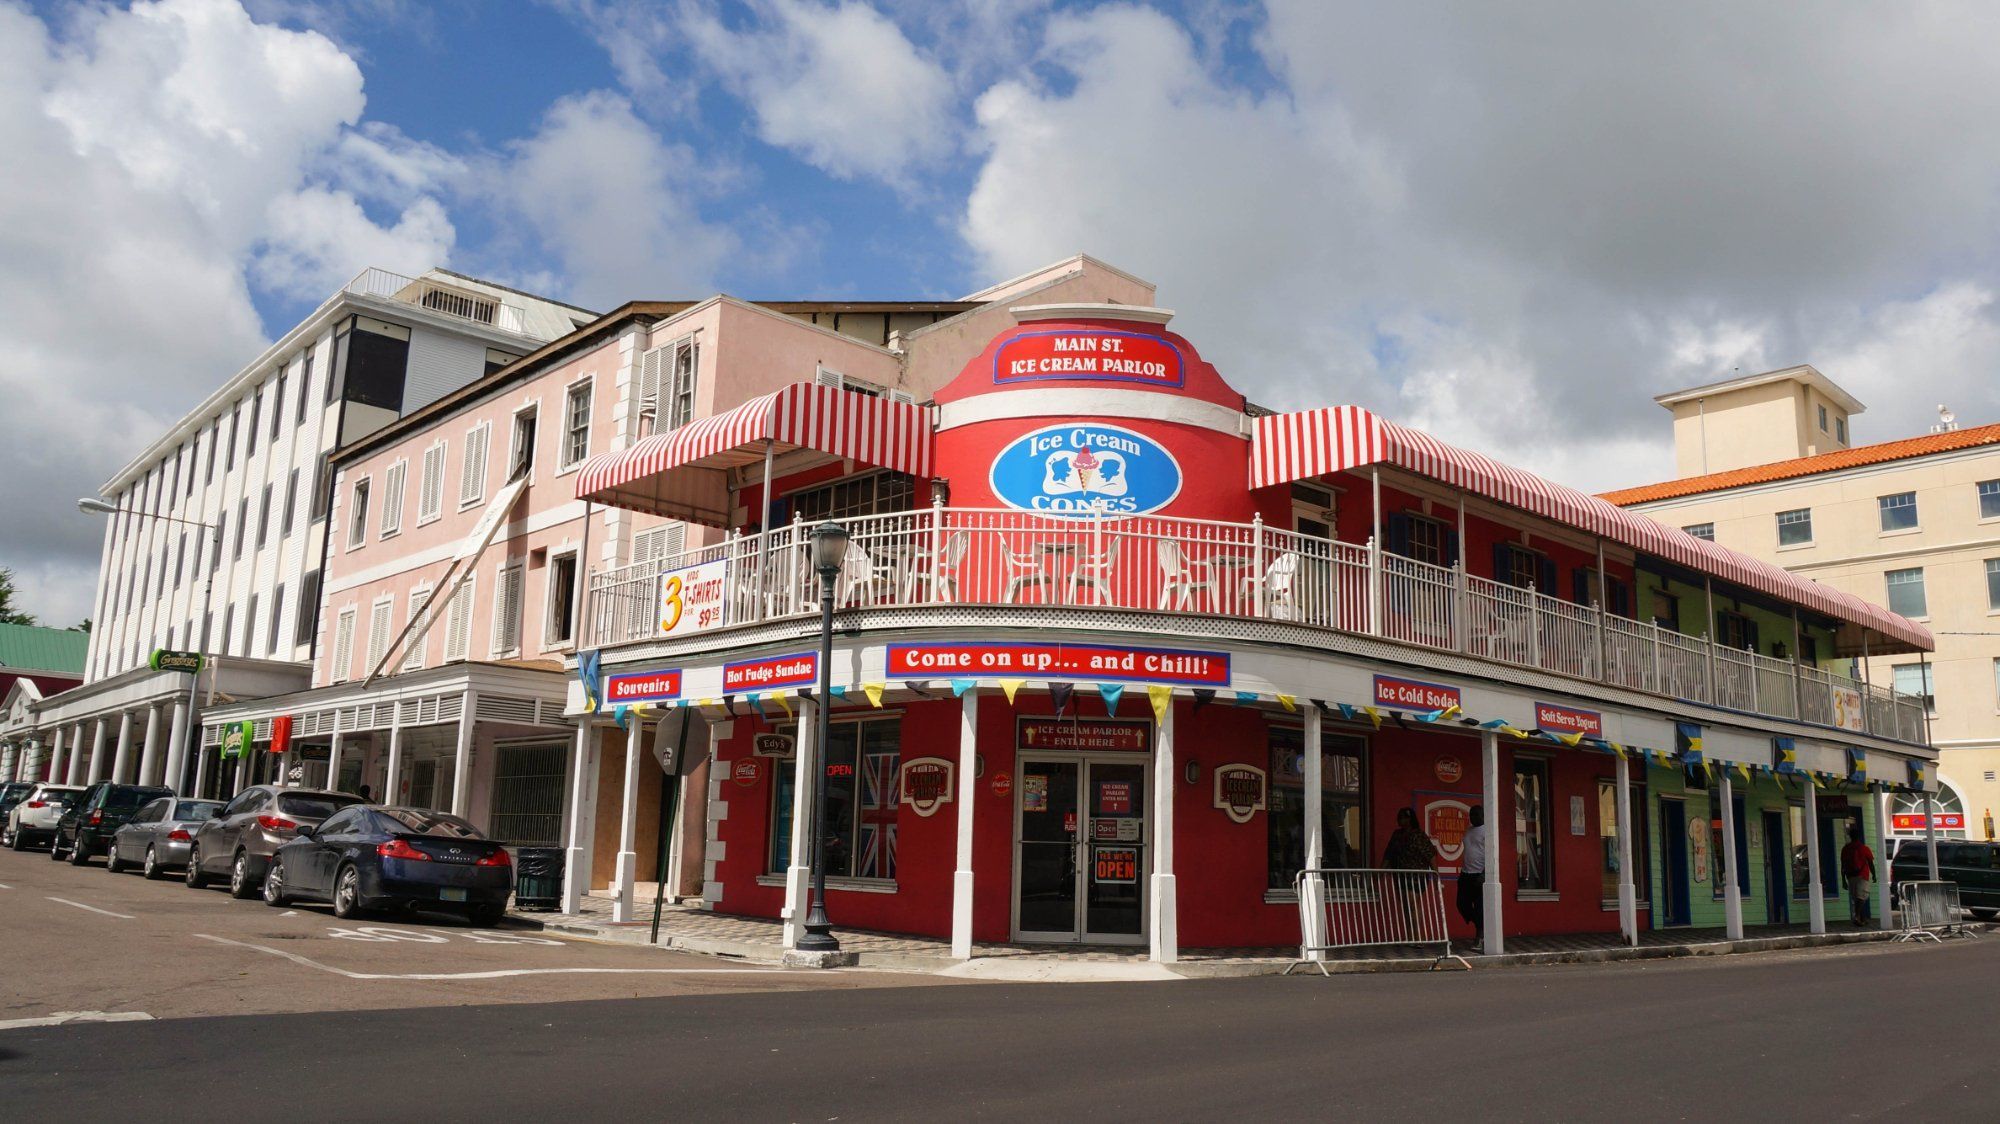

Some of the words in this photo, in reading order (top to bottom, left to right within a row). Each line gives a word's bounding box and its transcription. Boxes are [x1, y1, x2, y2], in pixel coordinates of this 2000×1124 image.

[1054, 337, 1097, 351] MAIN
[1101, 338, 1124, 353] ST.
[1011, 359, 1036, 374] ICE
[1040, 357, 1097, 372] CREAM
[1102, 358, 1166, 377] PARLOR
[1030, 431, 1063, 457] Ice
[1070, 428, 1141, 457] Cream
[1031, 495, 1138, 512] CONES
[684, 578, 721, 607] T-SHIRTS
[662, 575, 683, 632] 3
[906, 650, 972, 667] Come
[981, 652, 1011, 667] on
[1022, 652, 1078, 671] up...
[1090, 653, 1135, 670] and
[1145, 654, 1209, 675] Chill!
[727, 670, 743, 684] Hot
[745, 666, 773, 683] Fudge
[775, 662, 811, 678] Sundae
[617, 678, 670, 694] Souvenirs
[1378, 683, 1395, 699] Ice
[1398, 687, 1424, 704] Cold
[1427, 691, 1458, 707] Sodas
[1541, 709, 1556, 723] Soft
[1556, 713, 1575, 726] Serve
[1576, 715, 1597, 730] Yogurt
[1038, 726, 1054, 734] ICE
[1057, 726, 1090, 735] CREAM
[1093, 727, 1131, 736] PARLOR
[763, 738, 785, 749] Edy's
[1054, 738, 1086, 746] ENTER
[1089, 739, 1115, 747] HERE
[827, 765, 852, 776] OPEN
[1097, 861, 1134, 879] OPEN
